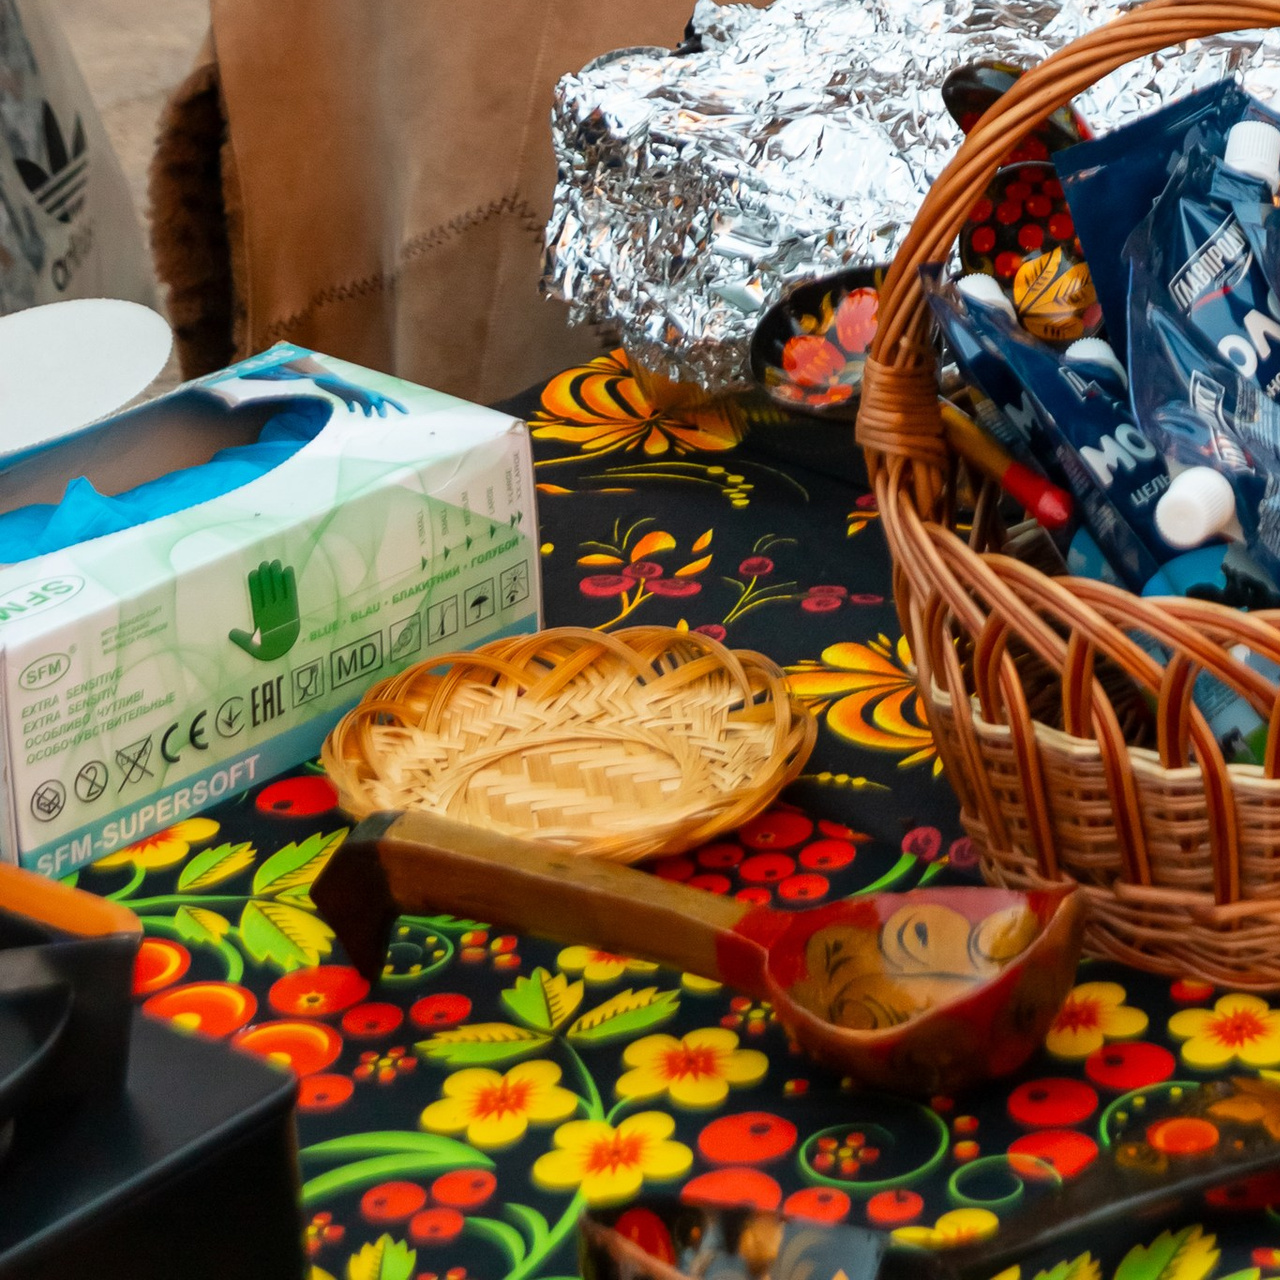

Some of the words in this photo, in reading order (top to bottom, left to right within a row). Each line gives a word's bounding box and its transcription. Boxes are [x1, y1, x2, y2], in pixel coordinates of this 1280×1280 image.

[1079, 423, 1157, 485] МО
[1130, 473, 1171, 507] ЦЕЛЬ
[309, 619, 339, 642] BLUE
[350, 601, 381, 624] BLAU
[26, 658, 62, 685] SFM
[337, 641, 378, 680] MD
[21, 694, 59, 719] EXTRA
[66, 666, 123, 700] SENSITIVE
[23, 711, 61, 734] EXTRA
[68, 685, 119, 716] SENSITIV
[25, 713, 91, 749] ОСОБЛИВО
[26, 692, 176, 765] ОСОБОЧУВСТВИТЕЛЬНЫЕ
[161, 710, 208, 763] CE
[37, 753, 261, 878] SFM-SUPERSOFT
